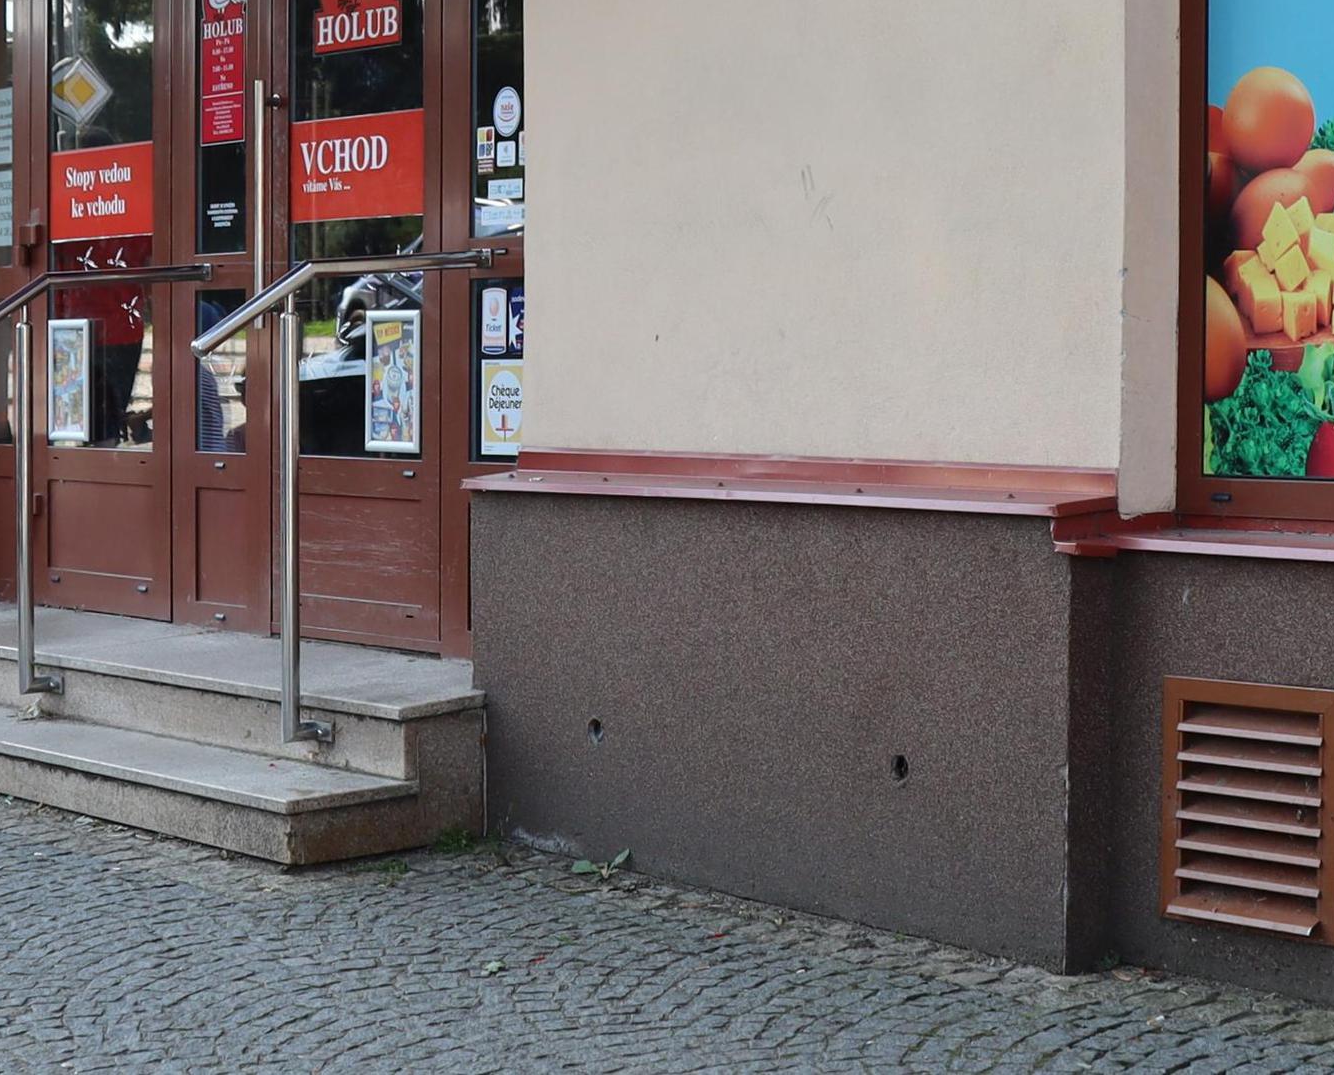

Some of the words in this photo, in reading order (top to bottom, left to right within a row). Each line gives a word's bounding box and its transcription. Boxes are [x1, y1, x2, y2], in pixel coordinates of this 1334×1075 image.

[203, 18, 243, 40] HOLUB
[317, 5, 398, 46] HOLUB
[300, 135, 388, 176] VCHOD
[66, 166, 96, 192] Stopy
[98, 162, 131, 184] vedou
[71, 197, 84, 218] ke
[86, 193, 126, 217] vchodu
[485, 323, 502, 333] Ticket
[491, 384, 520, 399] Chèque
[488, 397, 523, 412] Déjeuner
